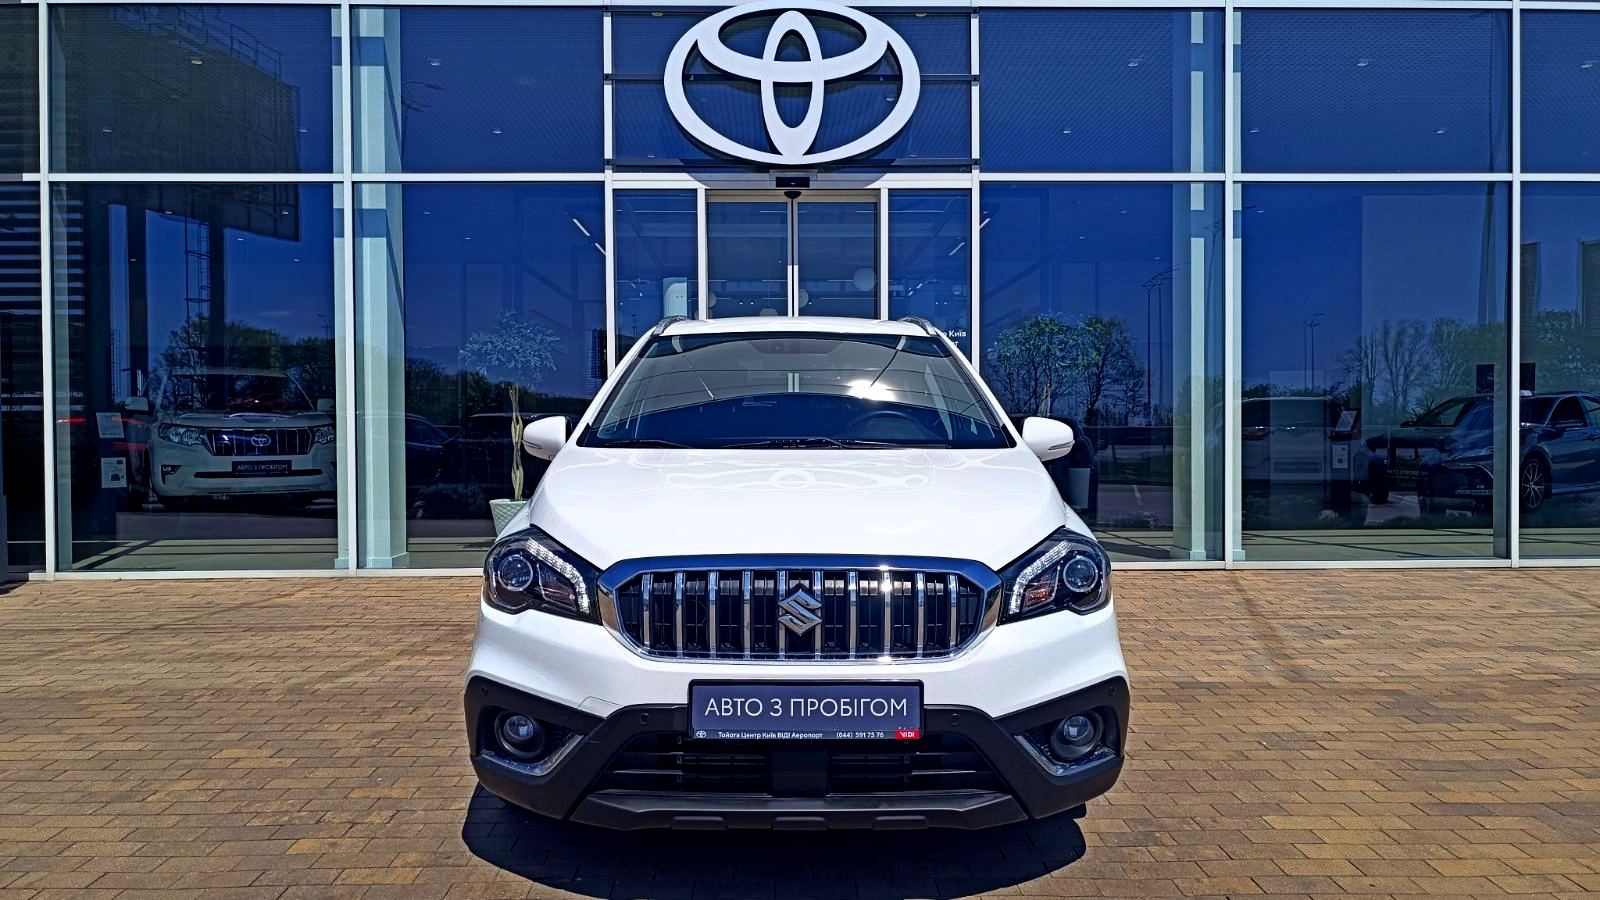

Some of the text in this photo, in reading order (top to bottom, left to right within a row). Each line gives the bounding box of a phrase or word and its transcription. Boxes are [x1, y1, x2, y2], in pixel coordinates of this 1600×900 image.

[949, 329, 967, 337] Київ
[704, 698, 907, 717] АВТО З ПРОБІГОМ
[741, 731, 762, 740] Центр
[791, 731, 823, 740] Аеропорт
[836, 731, 853, 739] (044)
